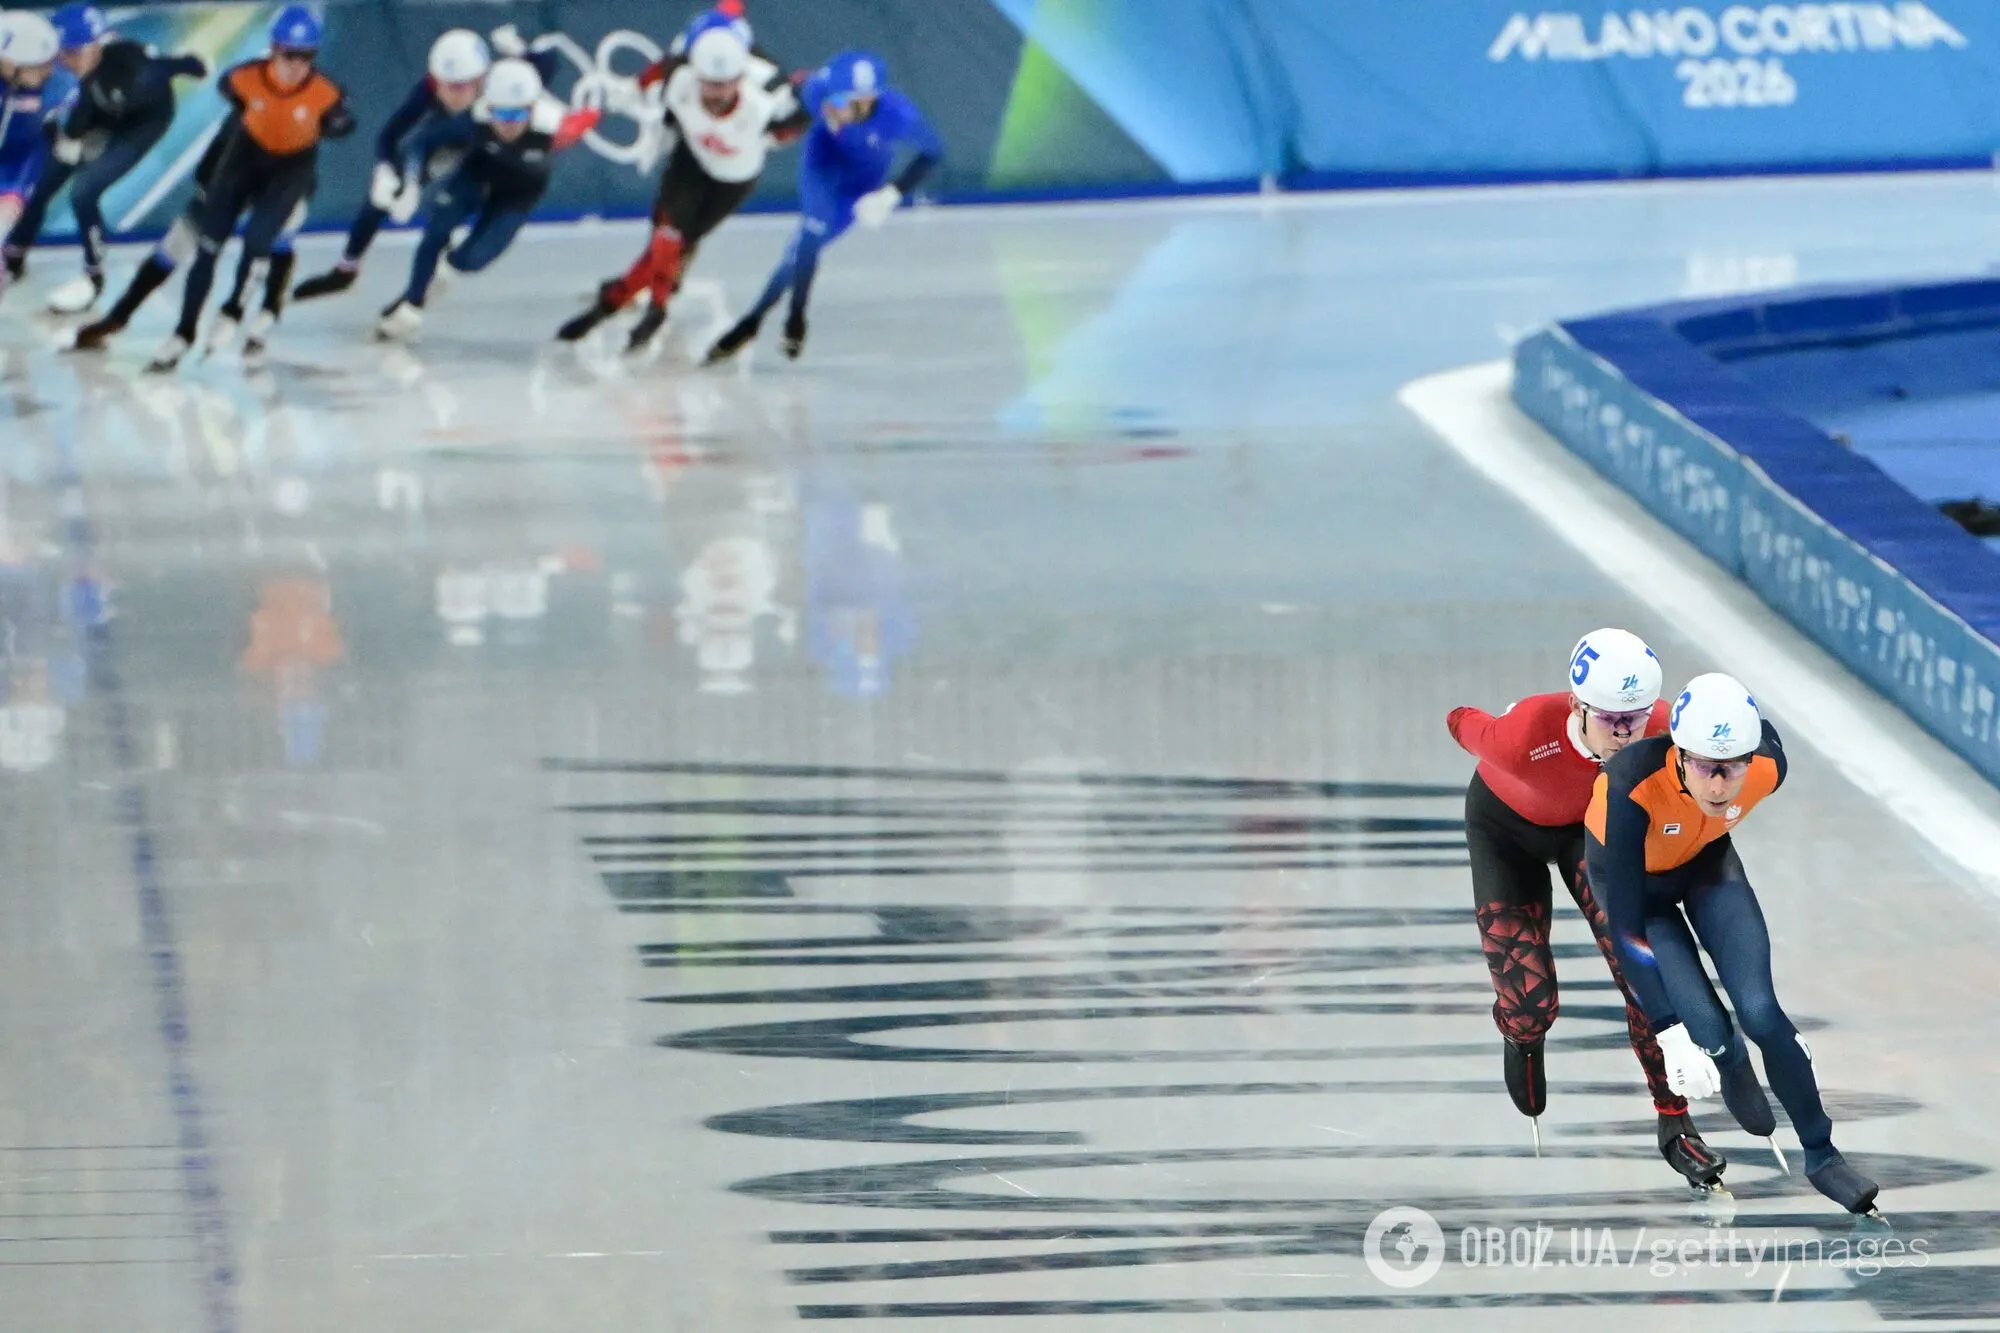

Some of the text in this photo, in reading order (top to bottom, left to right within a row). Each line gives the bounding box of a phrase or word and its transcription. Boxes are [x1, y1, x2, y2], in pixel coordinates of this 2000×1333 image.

[1488, 1, 1967, 62] MILANO CORTINA
[1676, 56, 1796, 107] 2026
[1671, 687, 1691, 731] 3
